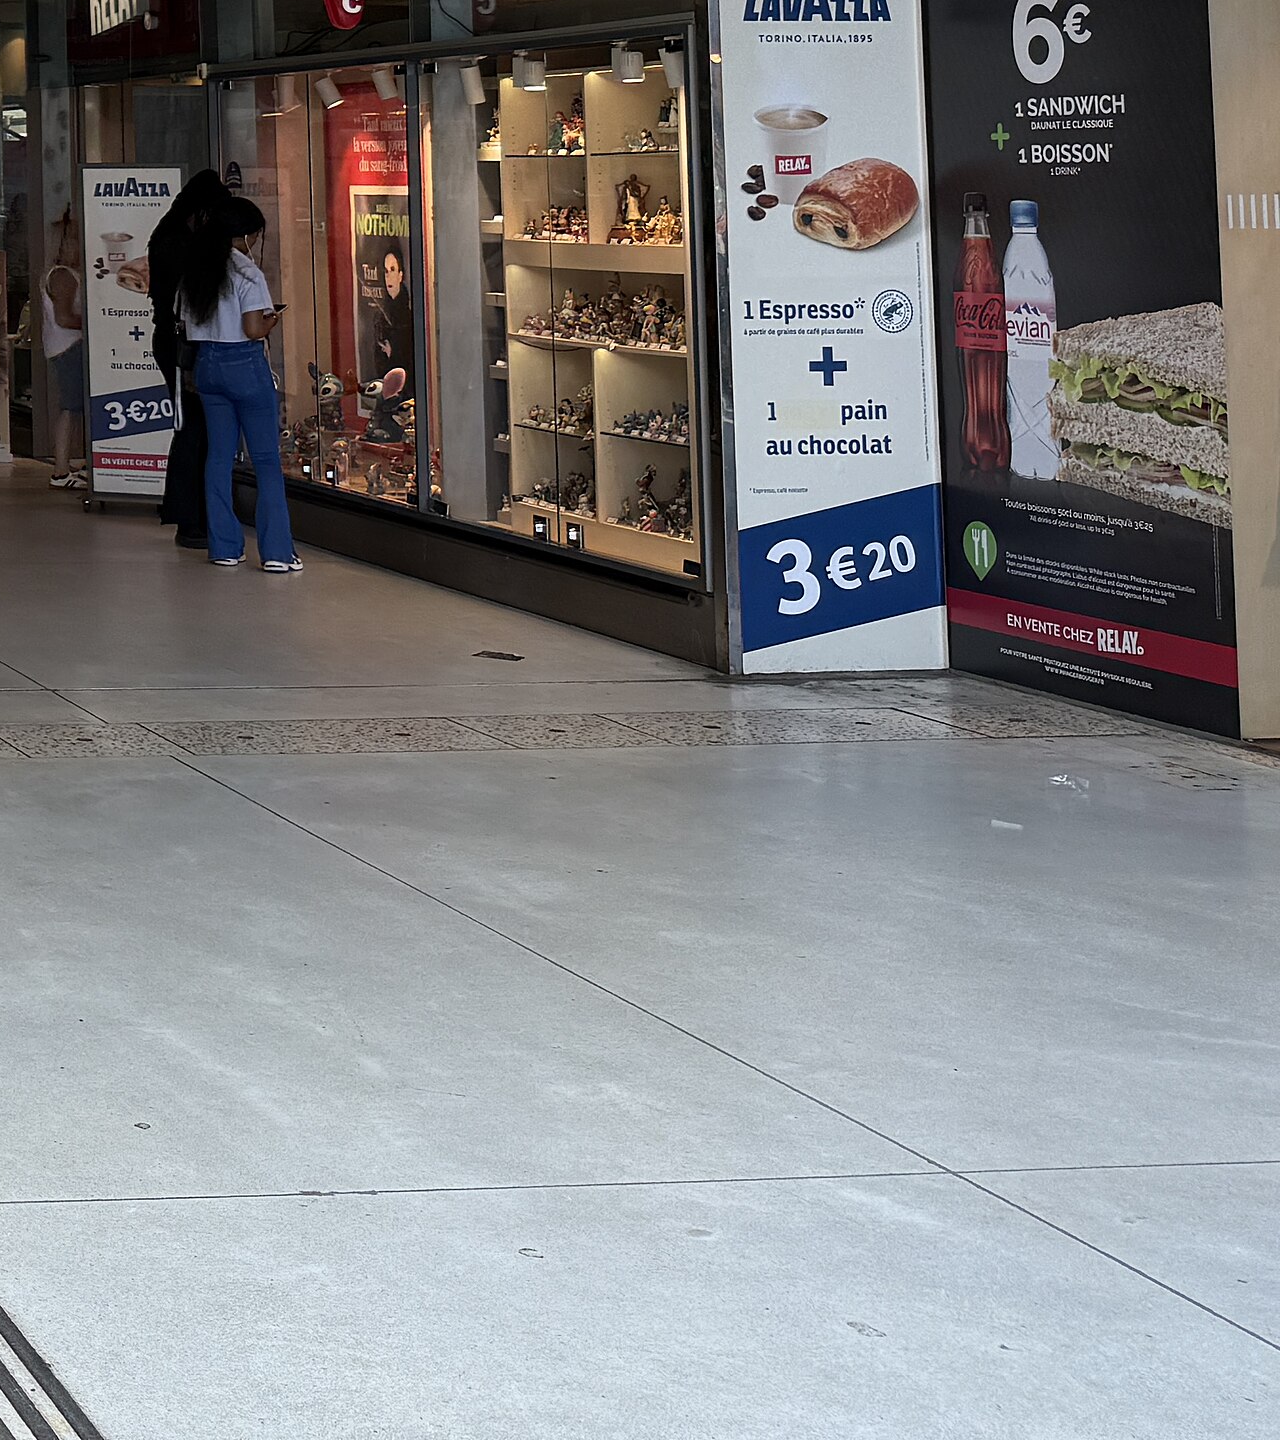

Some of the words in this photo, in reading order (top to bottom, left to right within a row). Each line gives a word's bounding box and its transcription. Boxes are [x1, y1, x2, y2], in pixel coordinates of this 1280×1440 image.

[1014, 102, 1024, 117] 1
[1027, 94, 1126, 117] SANDWICH
[1031, 120, 1061, 131] DAUNAT
[1062, 120, 1071, 130] LE
[1072, 119, 1114, 130] CLASSIQUE
[359, 155, 369, 172] du
[778, 158, 807, 171] RELAY
[1018, 148, 1027, 164] 1
[94, 178, 170, 197] LAVAZZA
[744, 301, 754, 319] 1
[749, 328, 767, 336] partir
[777, 328, 797, 337] grains
[807, 327, 820, 335] café
[821, 328, 835, 336] plus
[836, 327, 864, 335] durables
[1006, 317, 1050, 339] evian
[767, 402, 777, 420] 1
[841, 399, 887, 425] pain
[766, 440, 792, 455] au
[798, 435, 892, 455] chocolat
[1027, 503, 1056, 515] boissons
[1073, 511, 1083, 519] ou
[1007, 613, 1022, 629] EN
[1024, 616, 1060, 637] VENTE
[1063, 626, 1094, 644] CHEZ
[1097, 628, 1139, 655] RELAY
